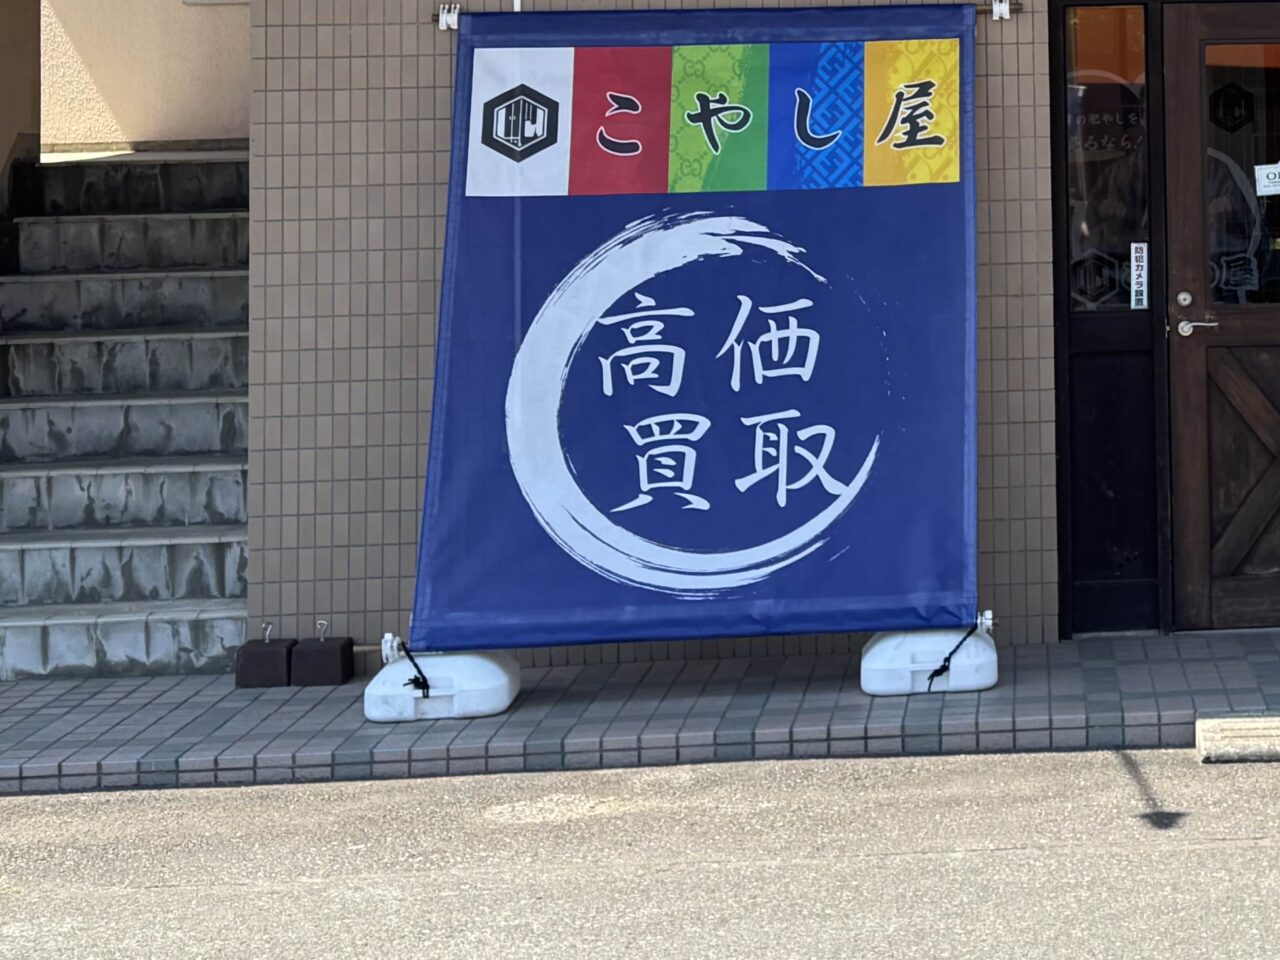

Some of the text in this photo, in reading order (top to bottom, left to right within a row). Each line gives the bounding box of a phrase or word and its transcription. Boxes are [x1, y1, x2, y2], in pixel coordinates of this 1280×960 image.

[595, 80, 946, 154] こやし屋
[1135, 246, 1144, 306] 防犯カメラ設置
[598, 293, 820, 397] 高価
[610, 408, 846, 511] 買取
